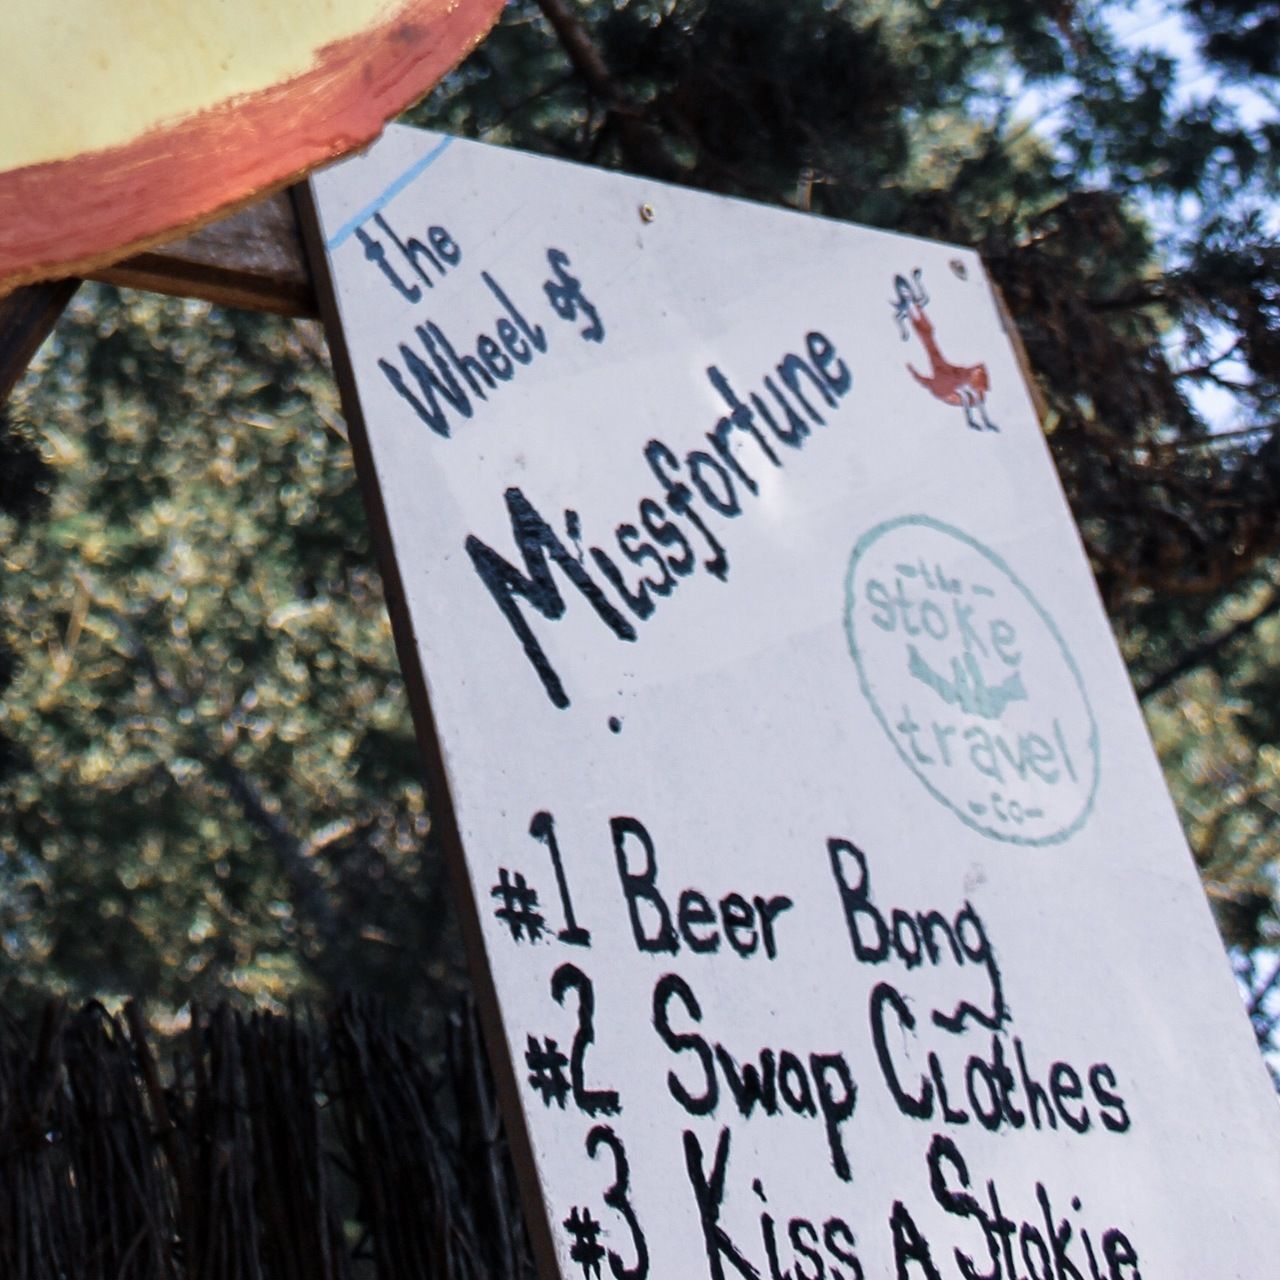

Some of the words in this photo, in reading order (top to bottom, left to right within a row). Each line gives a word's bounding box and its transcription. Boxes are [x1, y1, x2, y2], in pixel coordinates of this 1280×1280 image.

[355, 213, 460, 302] the
[378, 272, 546, 437] Wheel
[544, 249, 604, 342] of
[897, 704, 1078, 785] travel
[491, 812, 590, 947] #1
[610, 817, 792, 960] Beer
[828, 839, 1012, 1033] Bong
[524, 963, 622, 1121] #2
[653, 974, 857, 1185] Swap
[683, 1122, 864, 1280] Kiss
[890, 1200, 941, 1280] A
